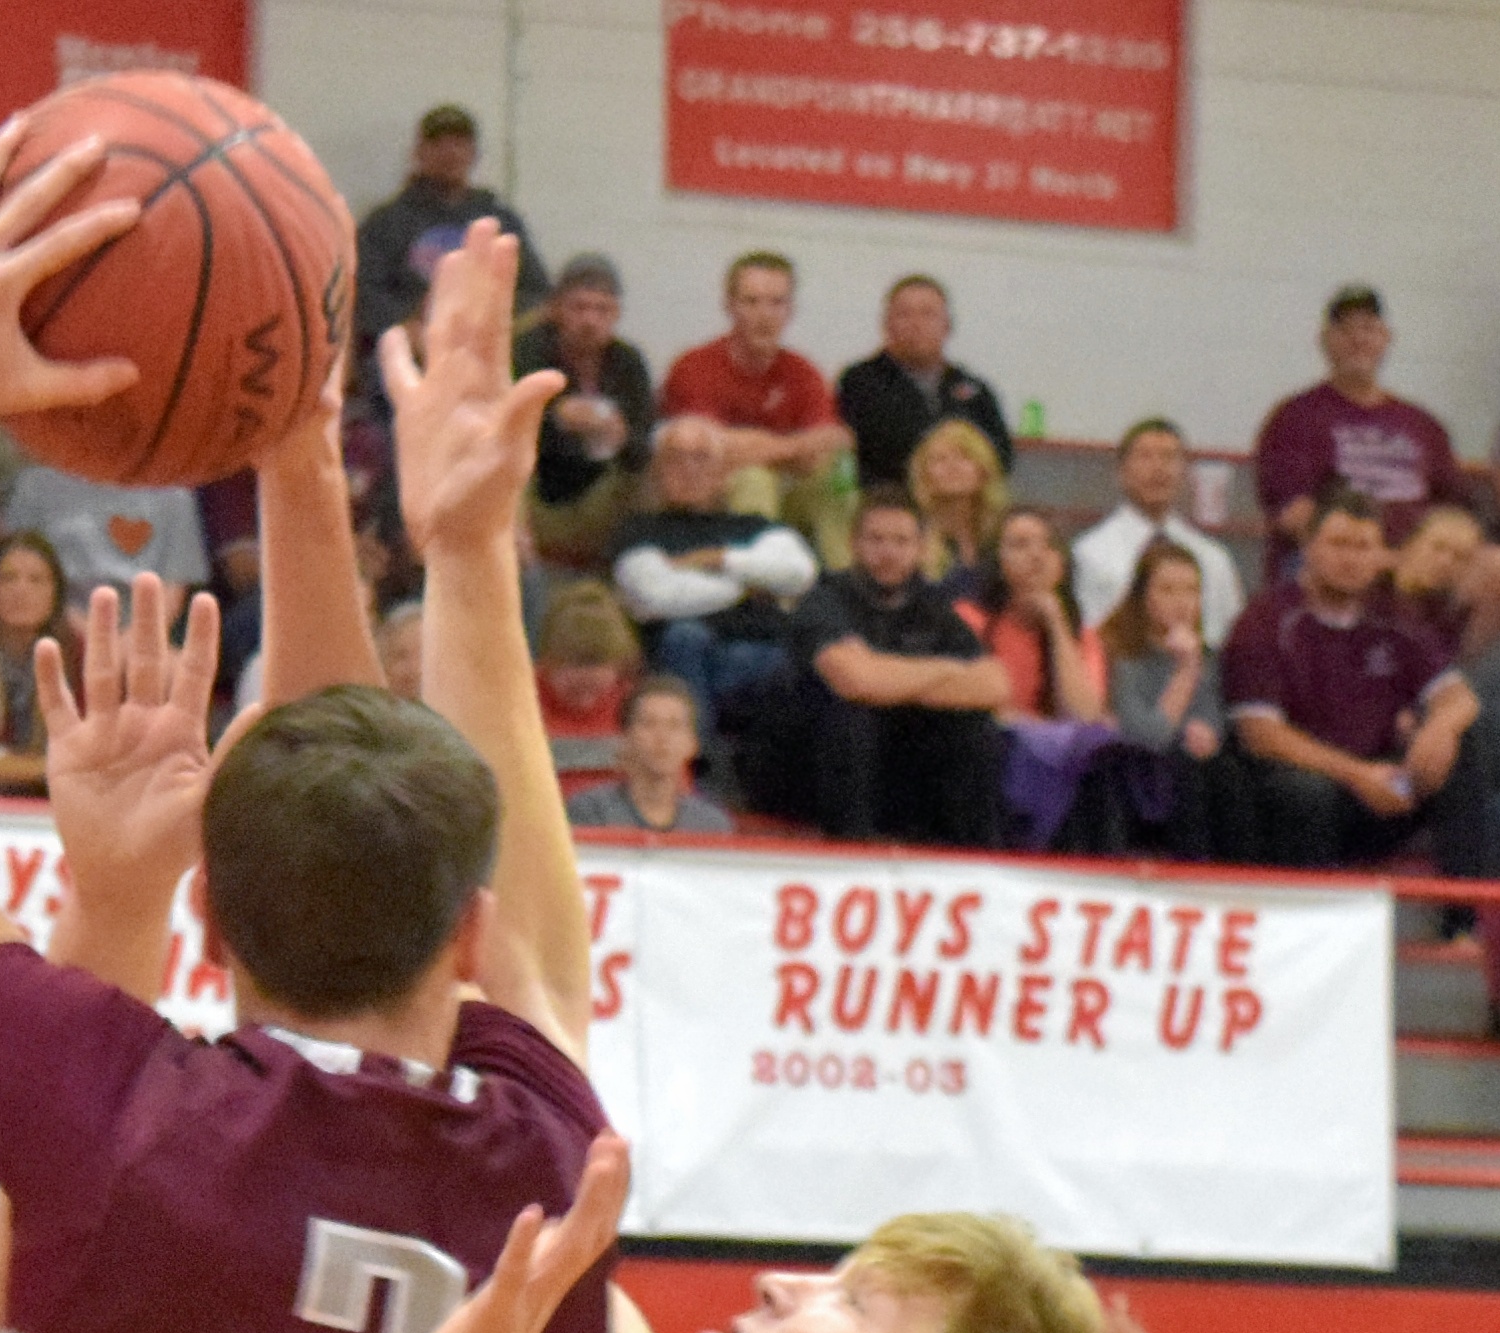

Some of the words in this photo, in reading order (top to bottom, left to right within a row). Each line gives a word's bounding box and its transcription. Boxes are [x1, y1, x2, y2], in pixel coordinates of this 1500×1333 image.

[773, 883, 984, 961] BOYS
[1018, 896, 1260, 981] STATE
[773, 961, 1110, 1053] RUNNER
[1157, 986, 1265, 1055] UP
[752, 1050, 968, 1097] 2002-03
